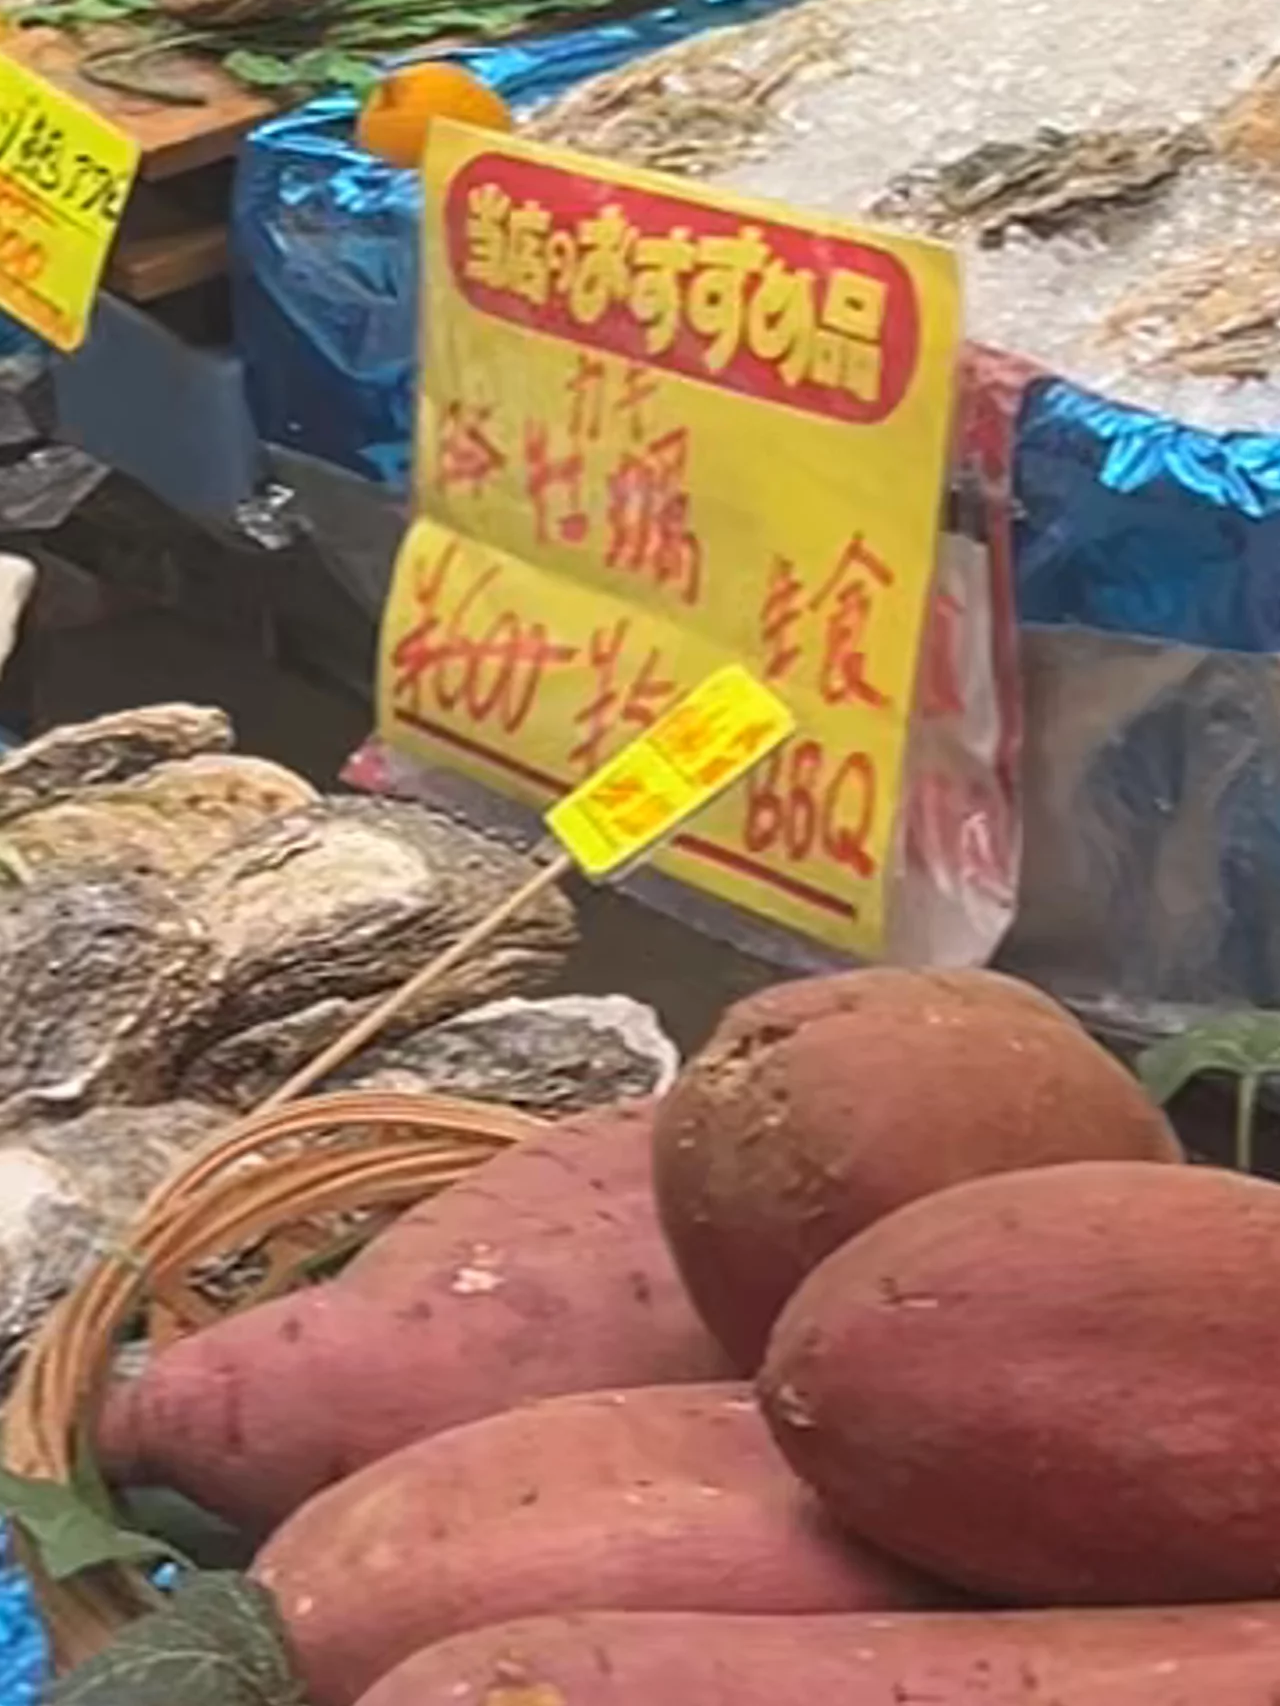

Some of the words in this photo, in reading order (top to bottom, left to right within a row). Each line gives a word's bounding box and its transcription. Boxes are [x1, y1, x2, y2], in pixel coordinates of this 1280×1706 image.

[464, 182, 888, 403] 当店のおすすめ品
